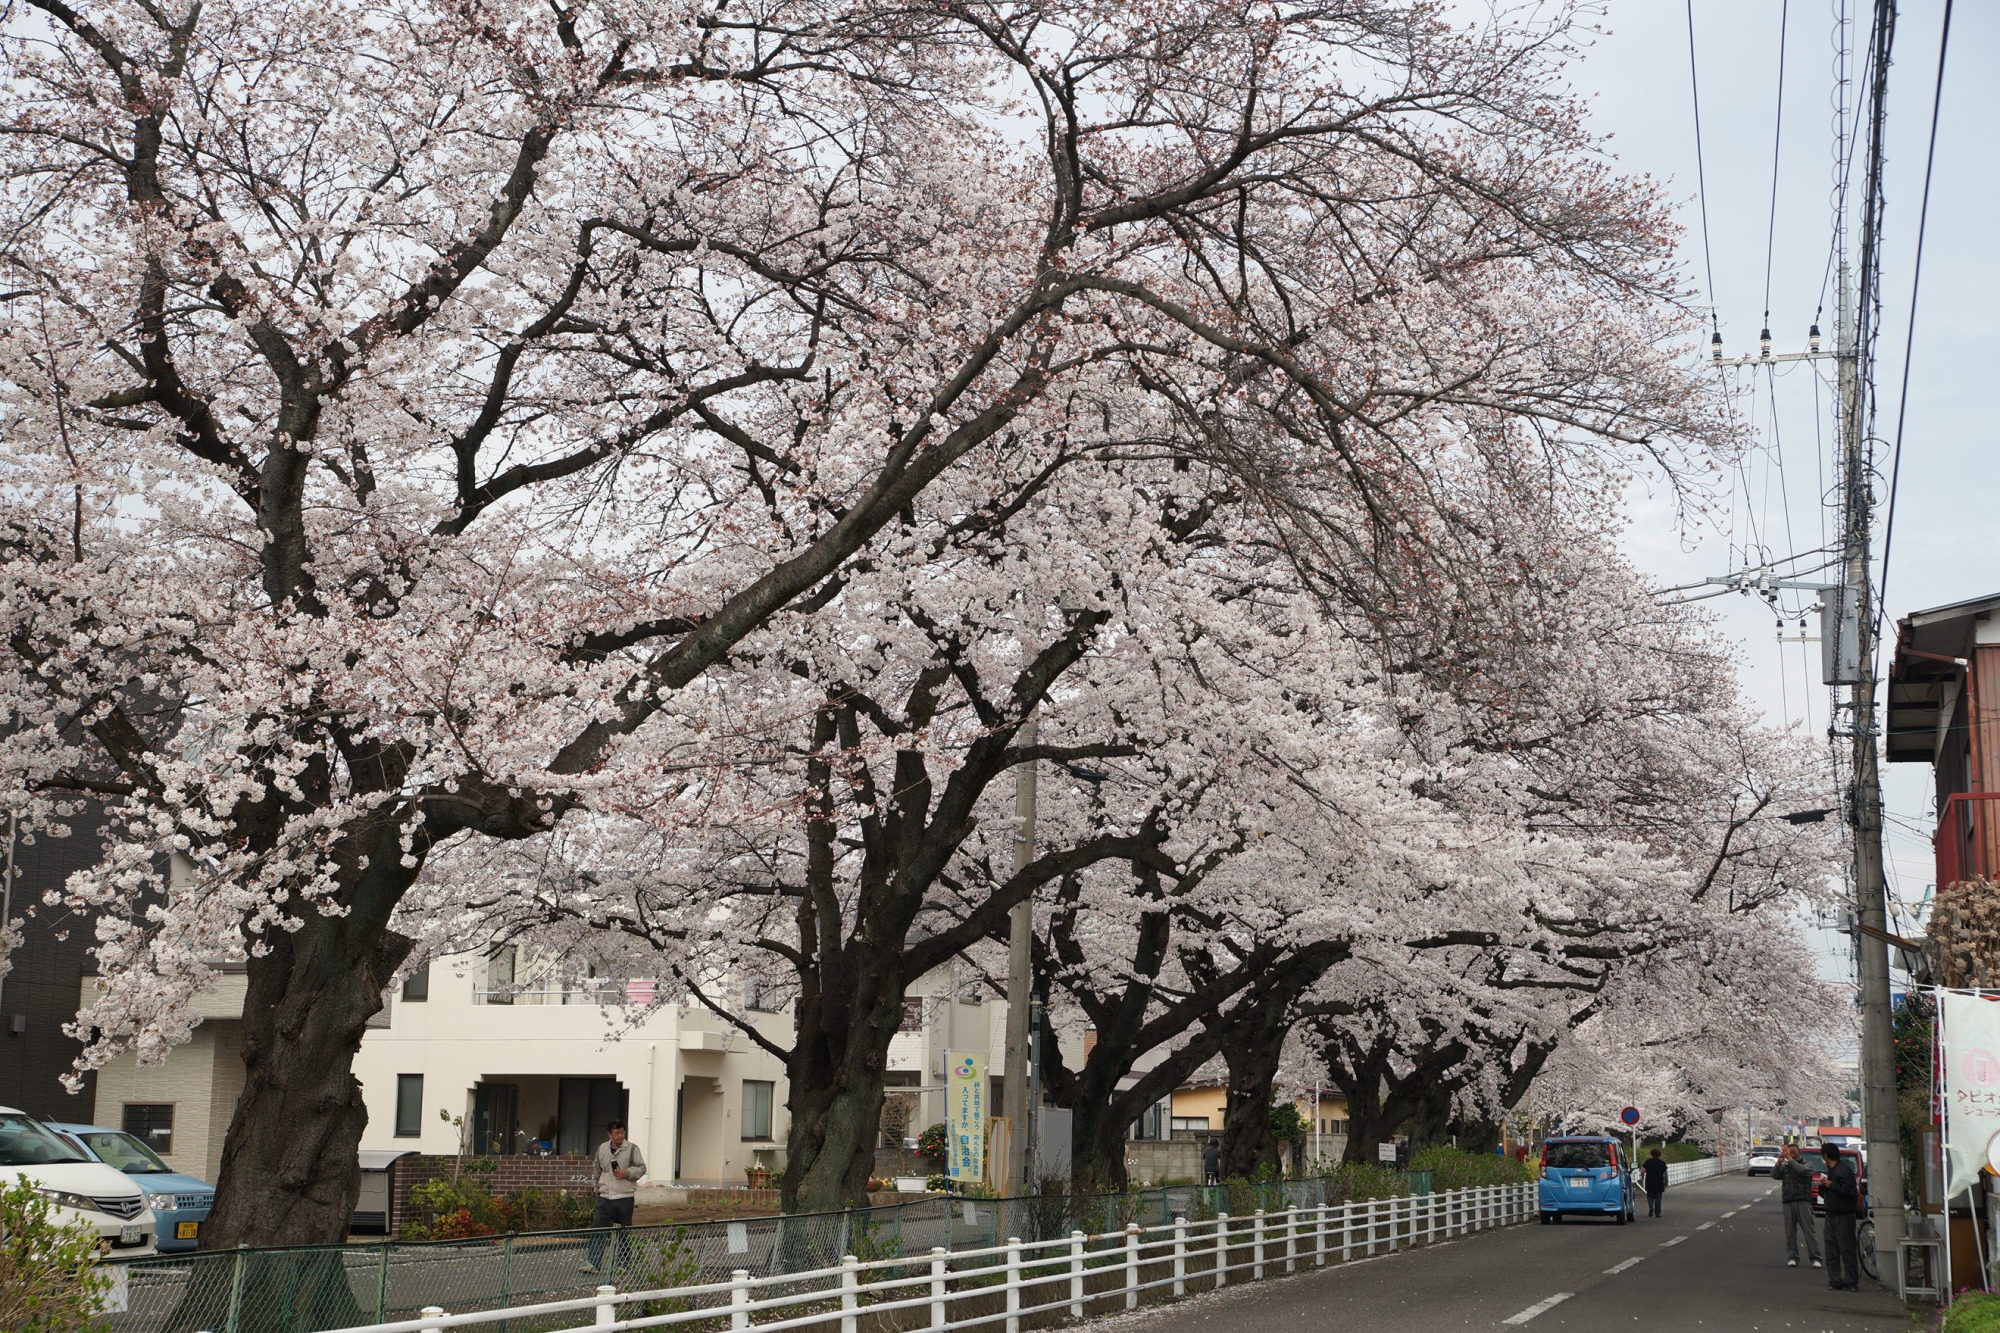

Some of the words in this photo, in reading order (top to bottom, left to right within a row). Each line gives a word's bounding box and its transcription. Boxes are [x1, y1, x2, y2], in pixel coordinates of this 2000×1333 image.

[972, 1134, 980, 1177] みんなの自治会
